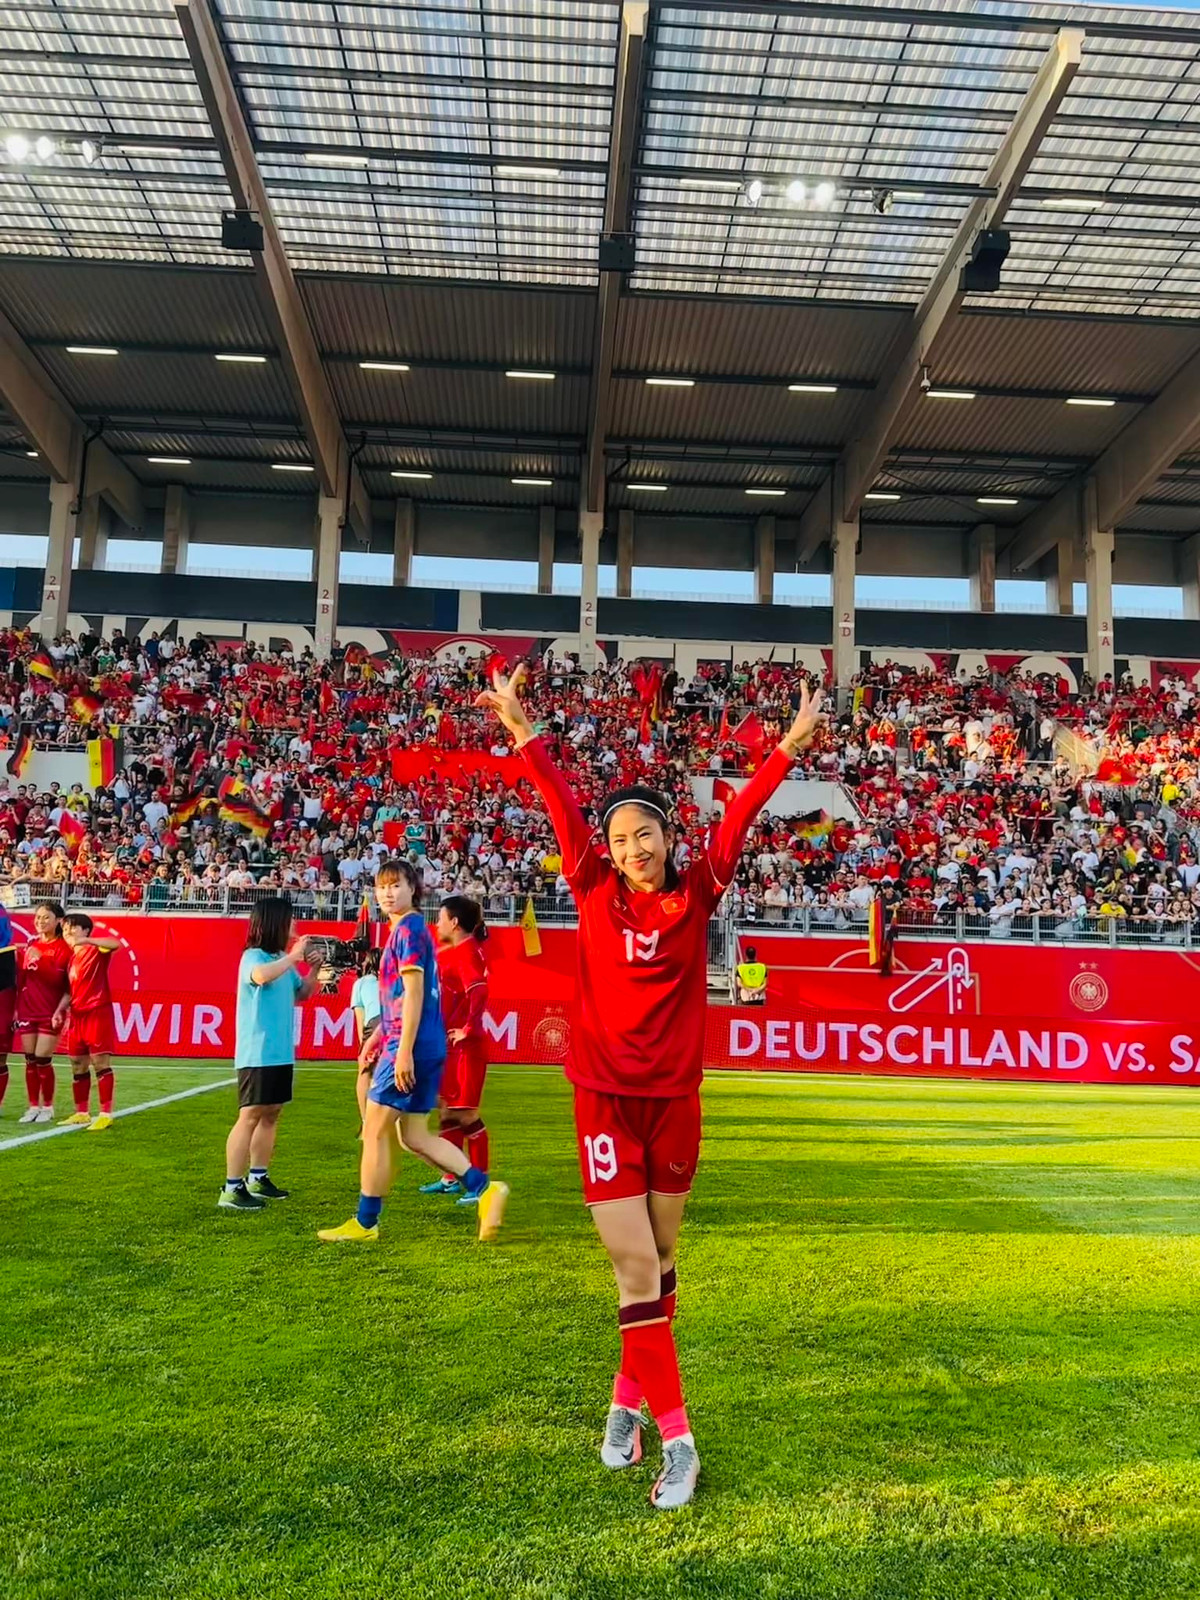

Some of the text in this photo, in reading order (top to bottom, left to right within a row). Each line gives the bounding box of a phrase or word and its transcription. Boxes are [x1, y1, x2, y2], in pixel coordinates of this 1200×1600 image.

[46, 590, 56, 600] A
[322, 589, 330, 599] 2
[321, 604, 330, 613] B
[585, 602, 592, 612] 2
[585, 617, 592, 626] C
[843, 613, 850, 622] 2
[841, 627, 851, 636] D
[1101, 637, 1110, 646] A
[622, 928, 659, 962] 19
[112, 1002, 223, 1045] WIR
[729, 1019, 1089, 1070] DEUTSCHLAND
[1168, 1034, 1200, 1073] S
[584, 1132, 618, 1184] 19
